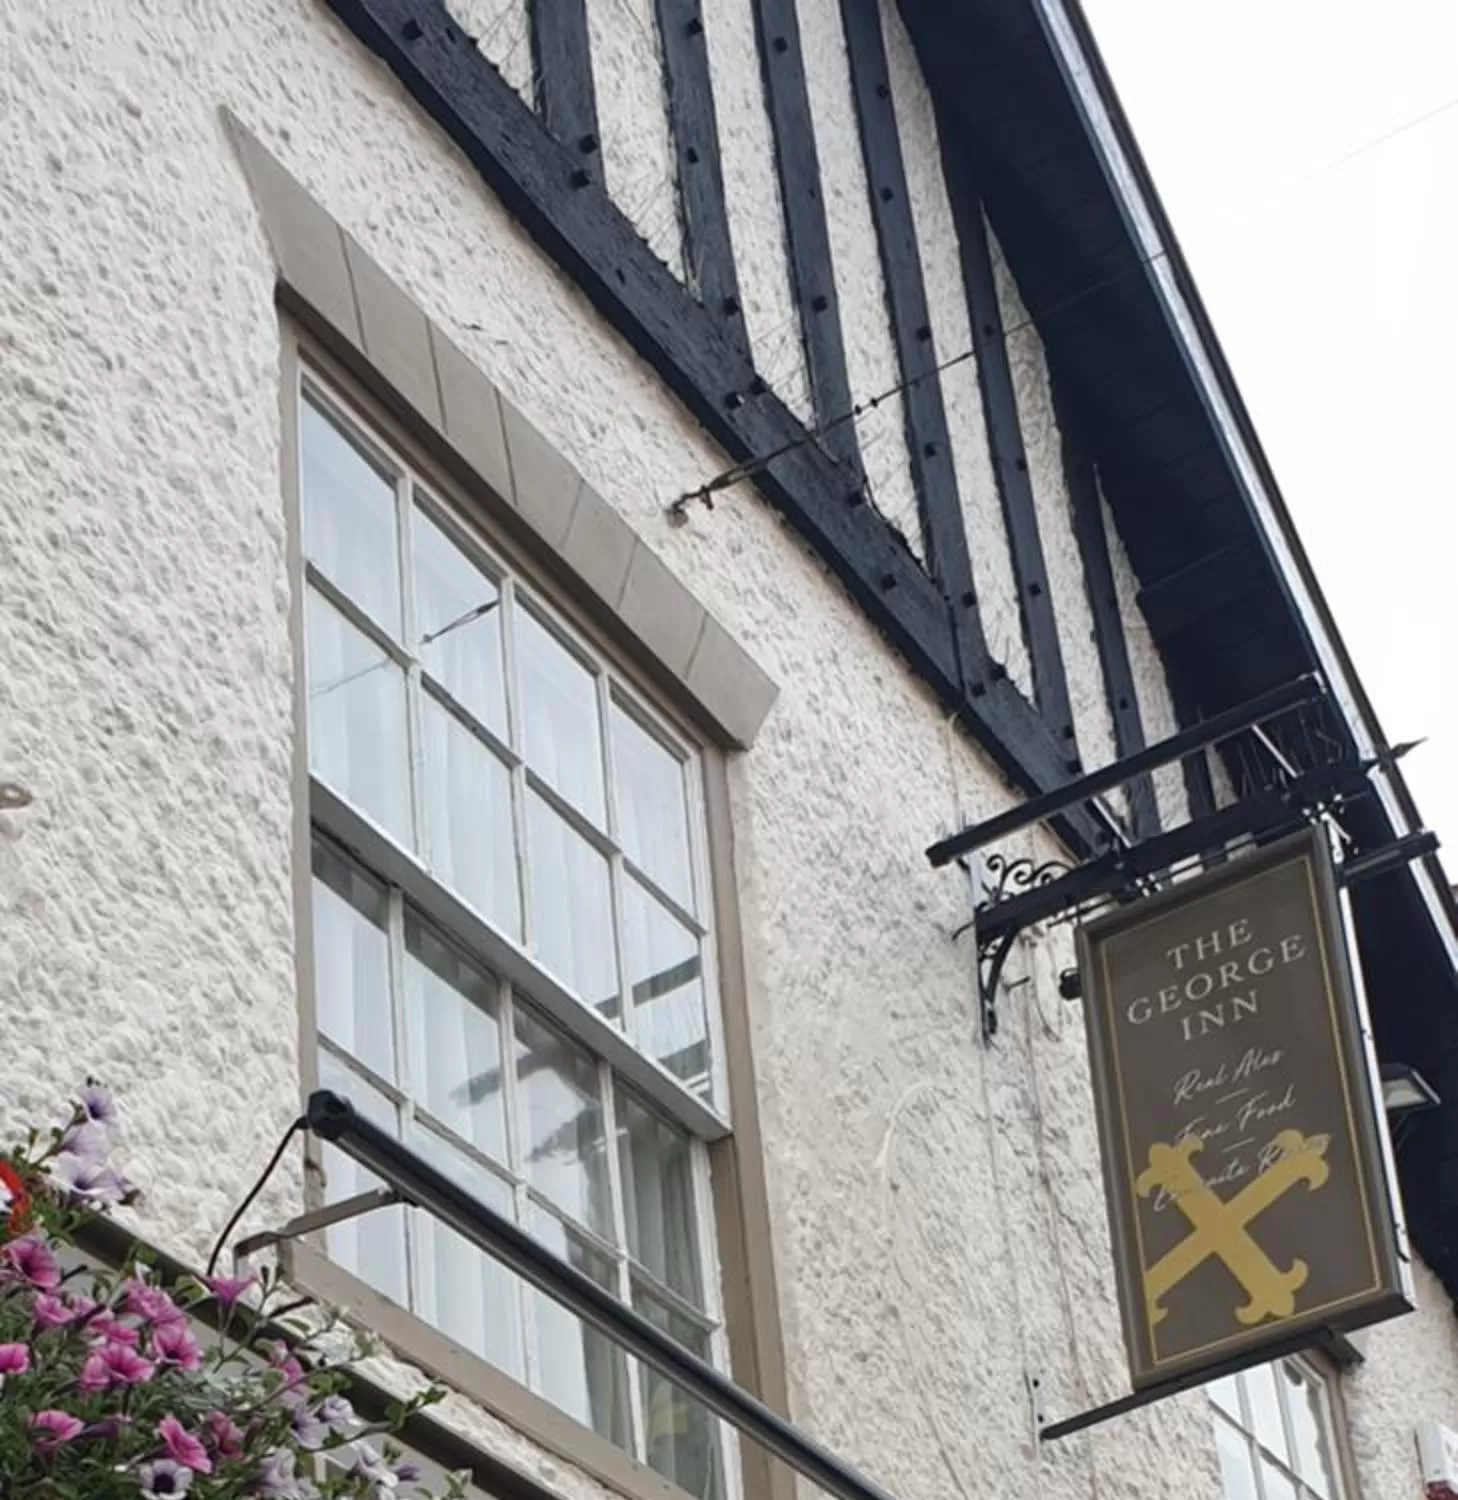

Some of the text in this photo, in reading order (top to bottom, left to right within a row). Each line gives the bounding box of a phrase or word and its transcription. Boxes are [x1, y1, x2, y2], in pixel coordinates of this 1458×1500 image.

[1167, 918, 1253, 970] THE
[1127, 934, 1306, 1025] GEORGE
[1180, 991, 1259, 1041] INN
[1173, 1047, 1284, 1107] Real Ales
[1236, 1083, 1297, 1133] Food
